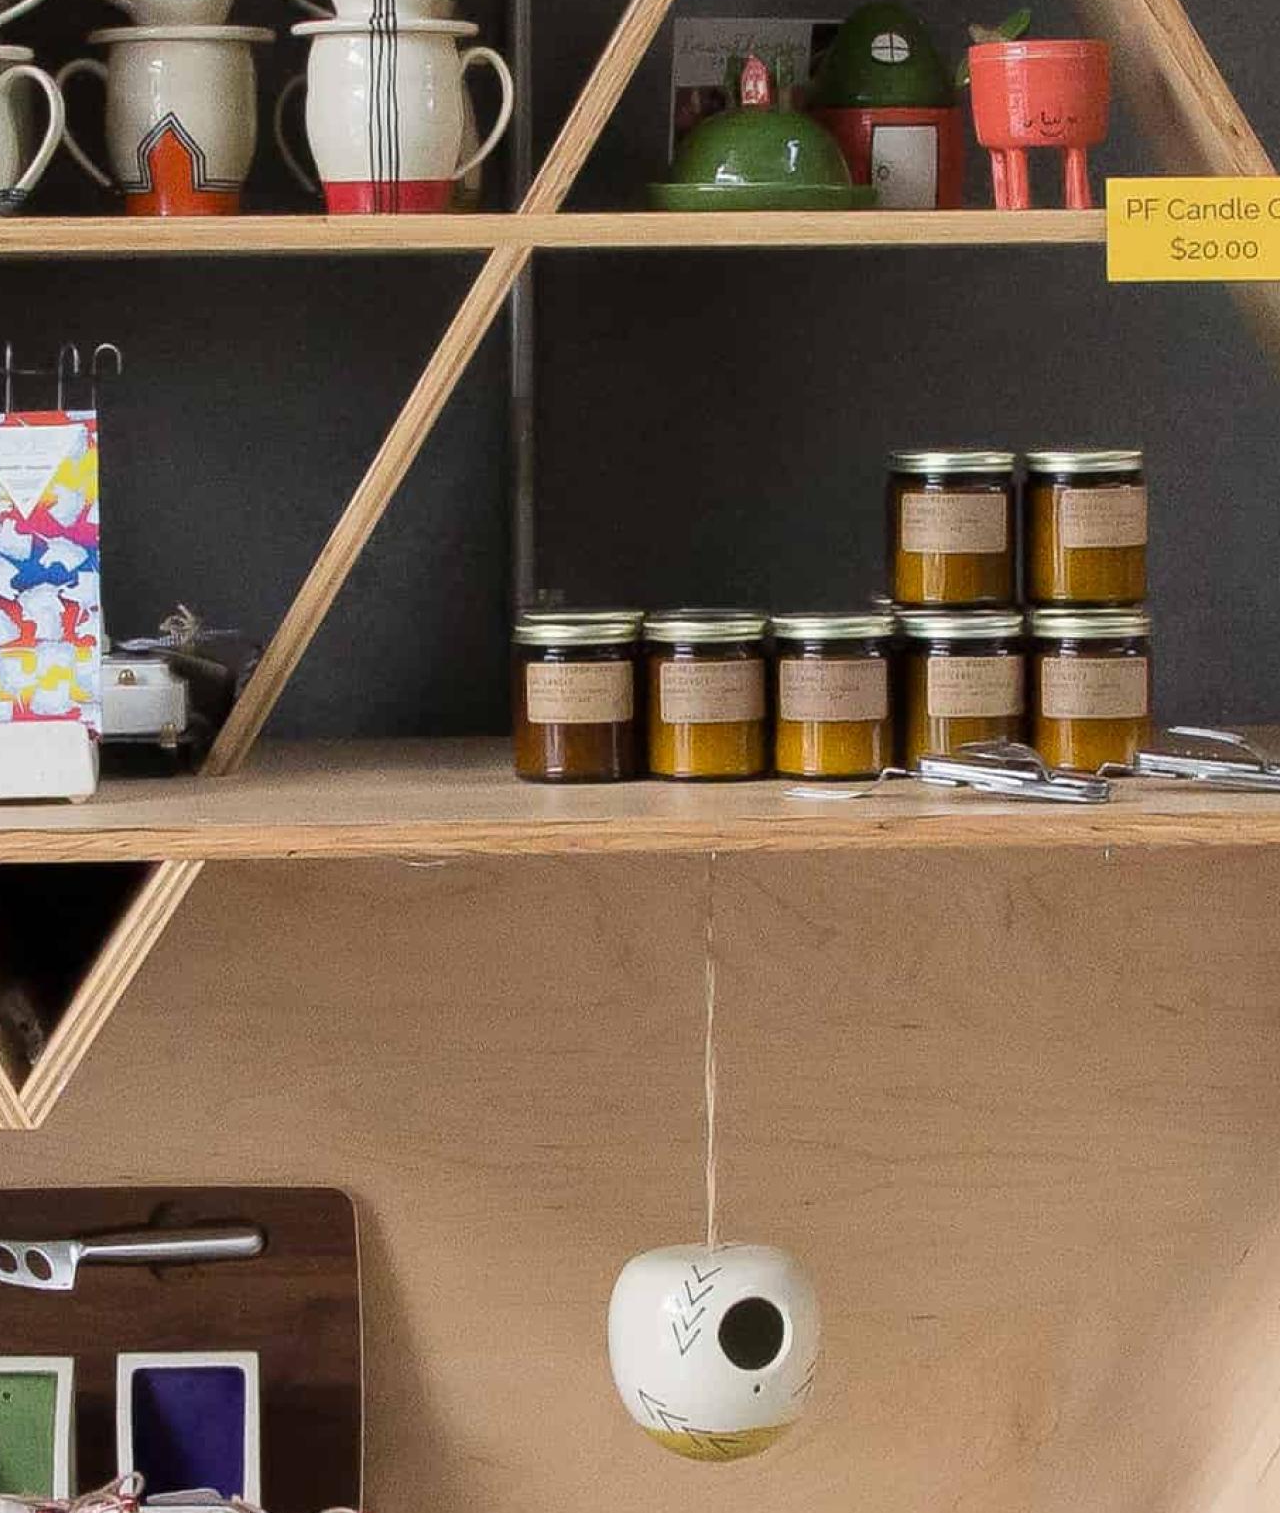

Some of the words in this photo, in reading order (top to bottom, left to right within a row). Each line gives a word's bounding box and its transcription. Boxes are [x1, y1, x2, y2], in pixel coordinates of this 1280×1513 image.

[1126, 198, 1159, 221] PF
[1168, 197, 1261, 222] Candle
[1170, 236, 1260, 262] $20.00
